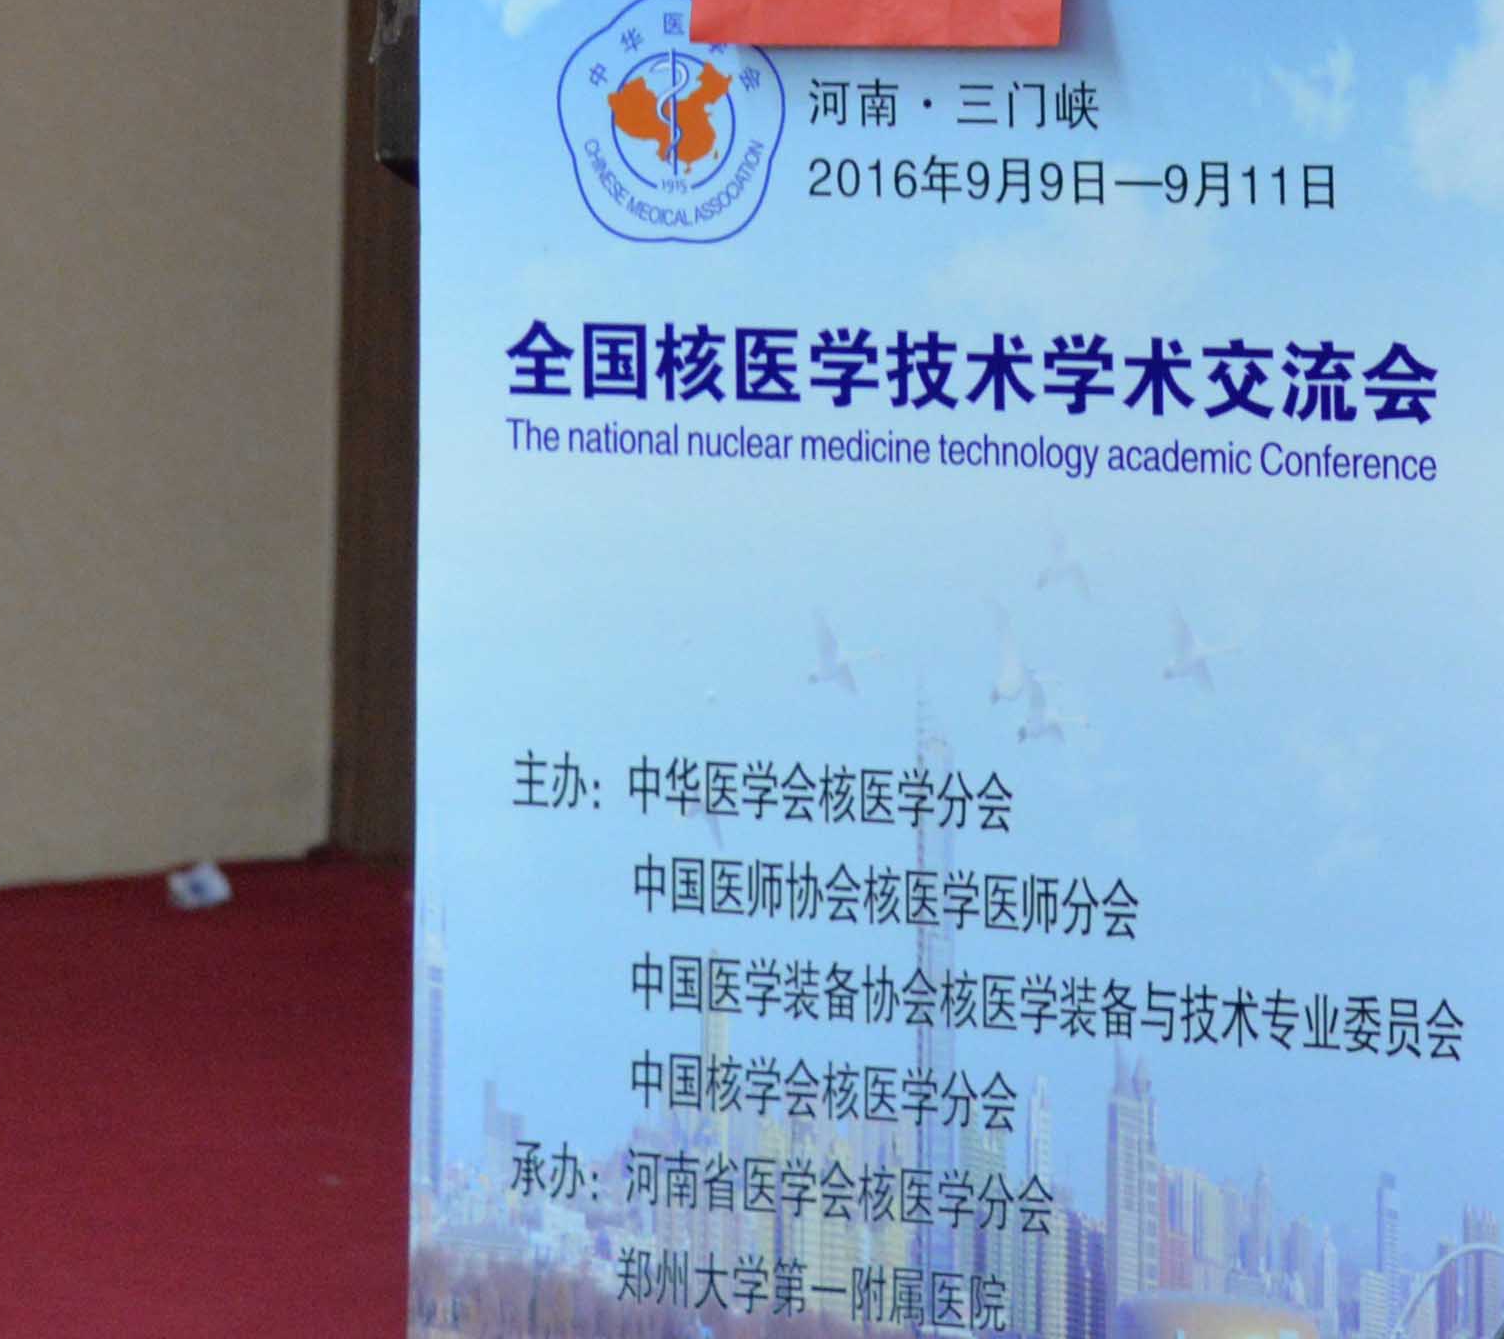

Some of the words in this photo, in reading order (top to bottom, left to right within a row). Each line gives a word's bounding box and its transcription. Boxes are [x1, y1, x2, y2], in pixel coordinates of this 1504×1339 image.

[808, 77, 1100, 131] 河南·三门峡
[506, 318, 1439, 425] 全国核医学技术学术交流会
[505, 418, 560, 452] The
[568, 421, 679, 456] national
[687, 425, 794, 460] nuclear
[800, 430, 931, 465] medicine
[938, 433, 1099, 478] technology
[1107, 439, 1252, 476] academic
[1259, 442, 1438, 482] Conference
[634, 854, 1139, 940] 中国医师协会核医学医师分会
[631, 951, 1465, 1063] 中国医学装备协会核医学装备与技术专业委员会
[631, 1049, 1018, 1132] 中国核学会核医学分会
[617, 1246, 1007, 1333] 郑州大学第一附属医院
